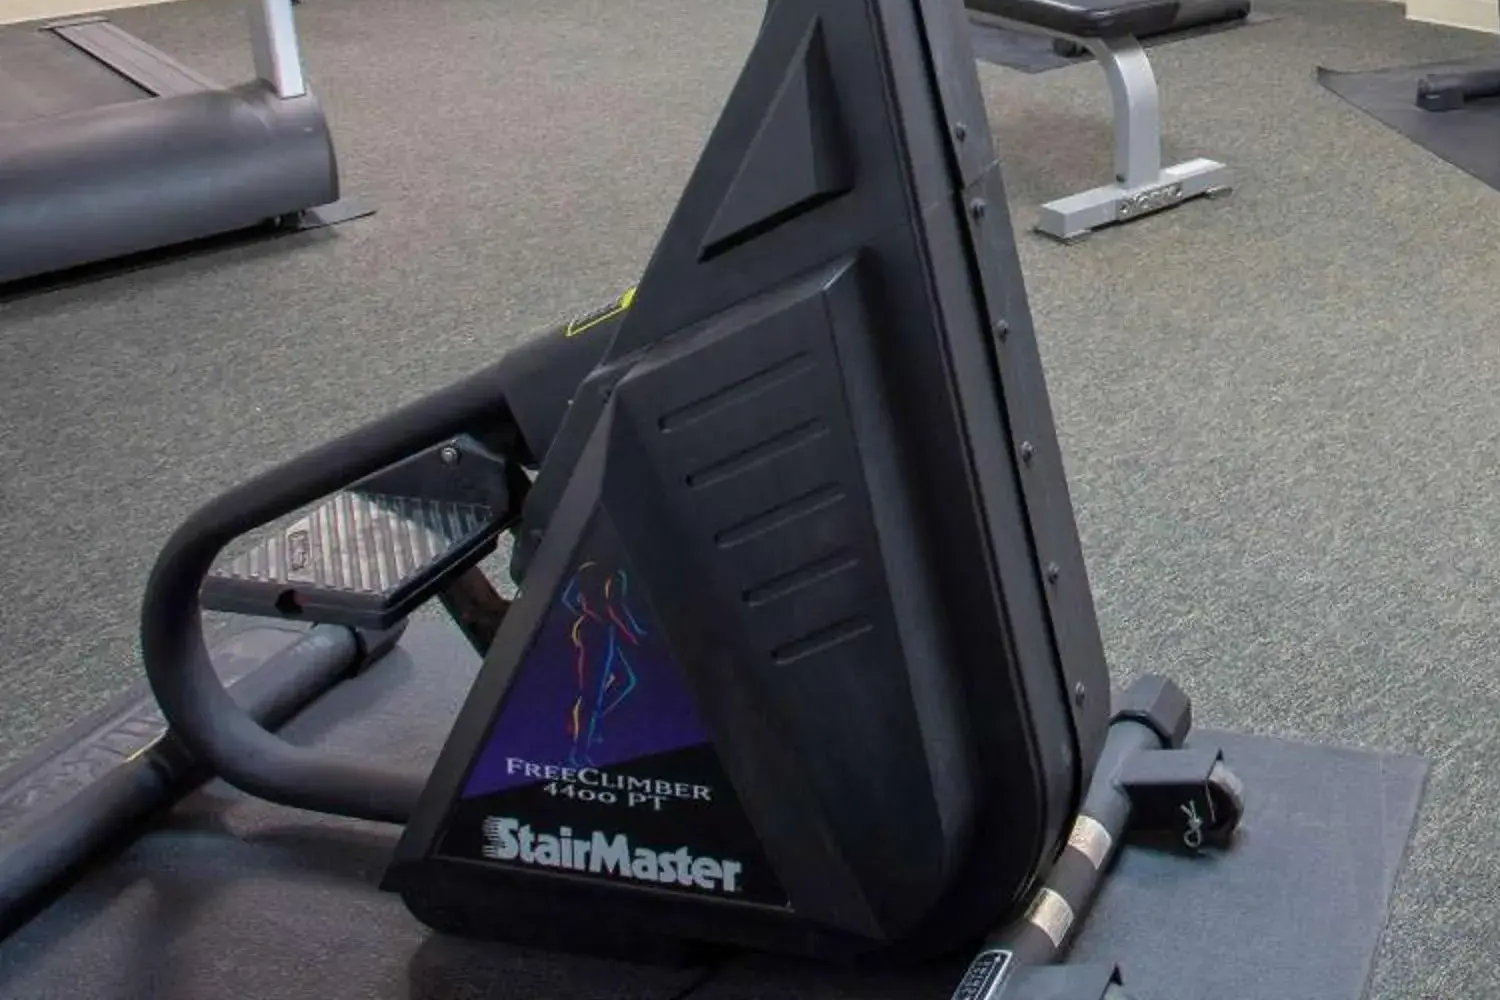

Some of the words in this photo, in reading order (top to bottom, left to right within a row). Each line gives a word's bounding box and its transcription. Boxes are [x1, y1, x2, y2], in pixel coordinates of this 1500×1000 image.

[543, 781, 617, 805] 4400
[628, 792, 668, 811] PT
[483, 815, 743, 893] StairMaster
